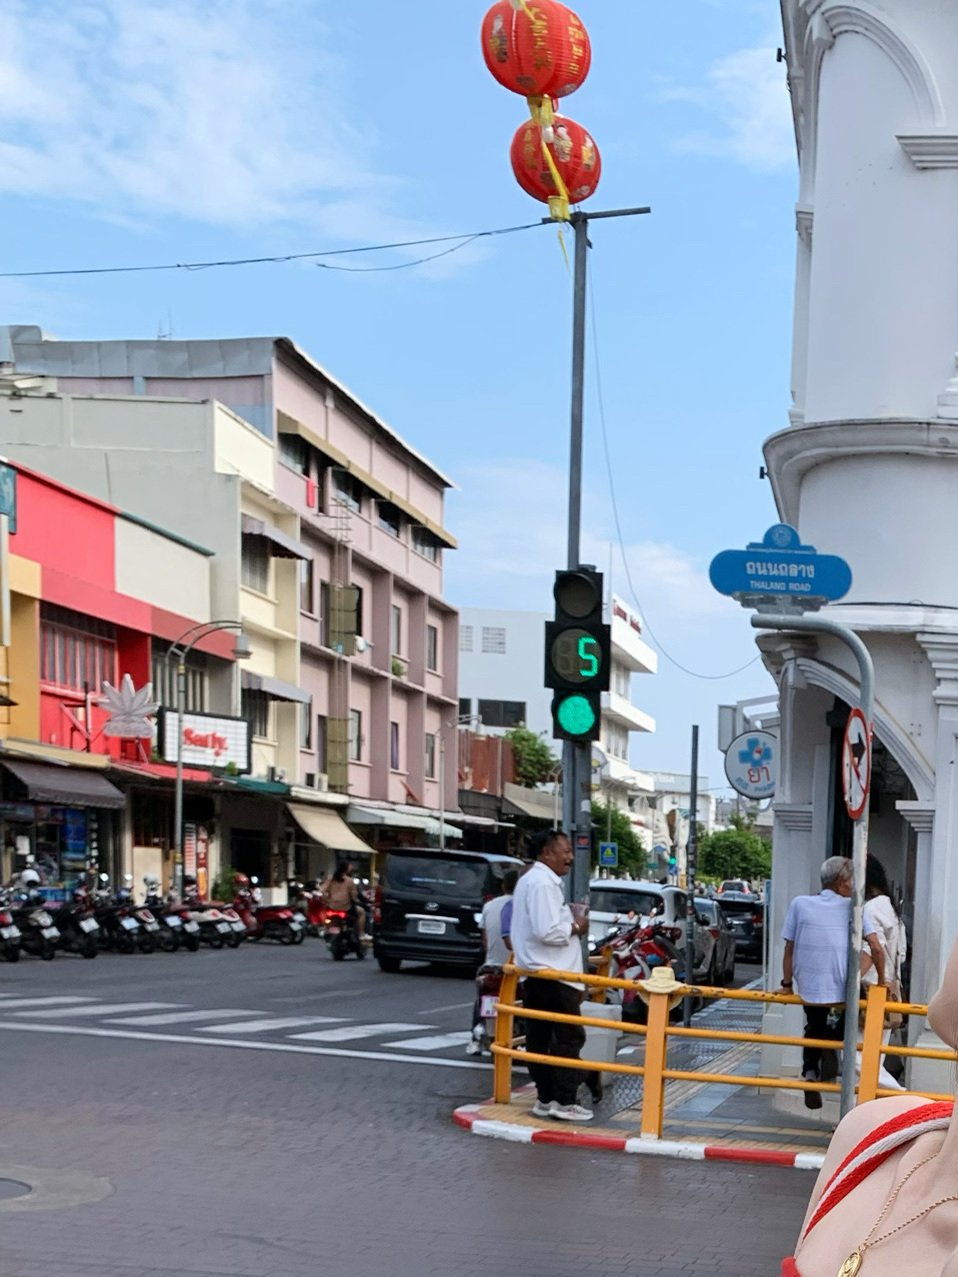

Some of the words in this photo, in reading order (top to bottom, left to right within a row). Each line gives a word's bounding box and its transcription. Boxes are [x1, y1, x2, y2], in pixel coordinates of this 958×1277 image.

[746, 562, 815, 578] ถนนถลาง
[750, 580, 786, 591] THALANG
[788, 582, 811, 592] ROAD
[578, 636, 598, 677] 5
[747, 766, 770, 783] ยา
